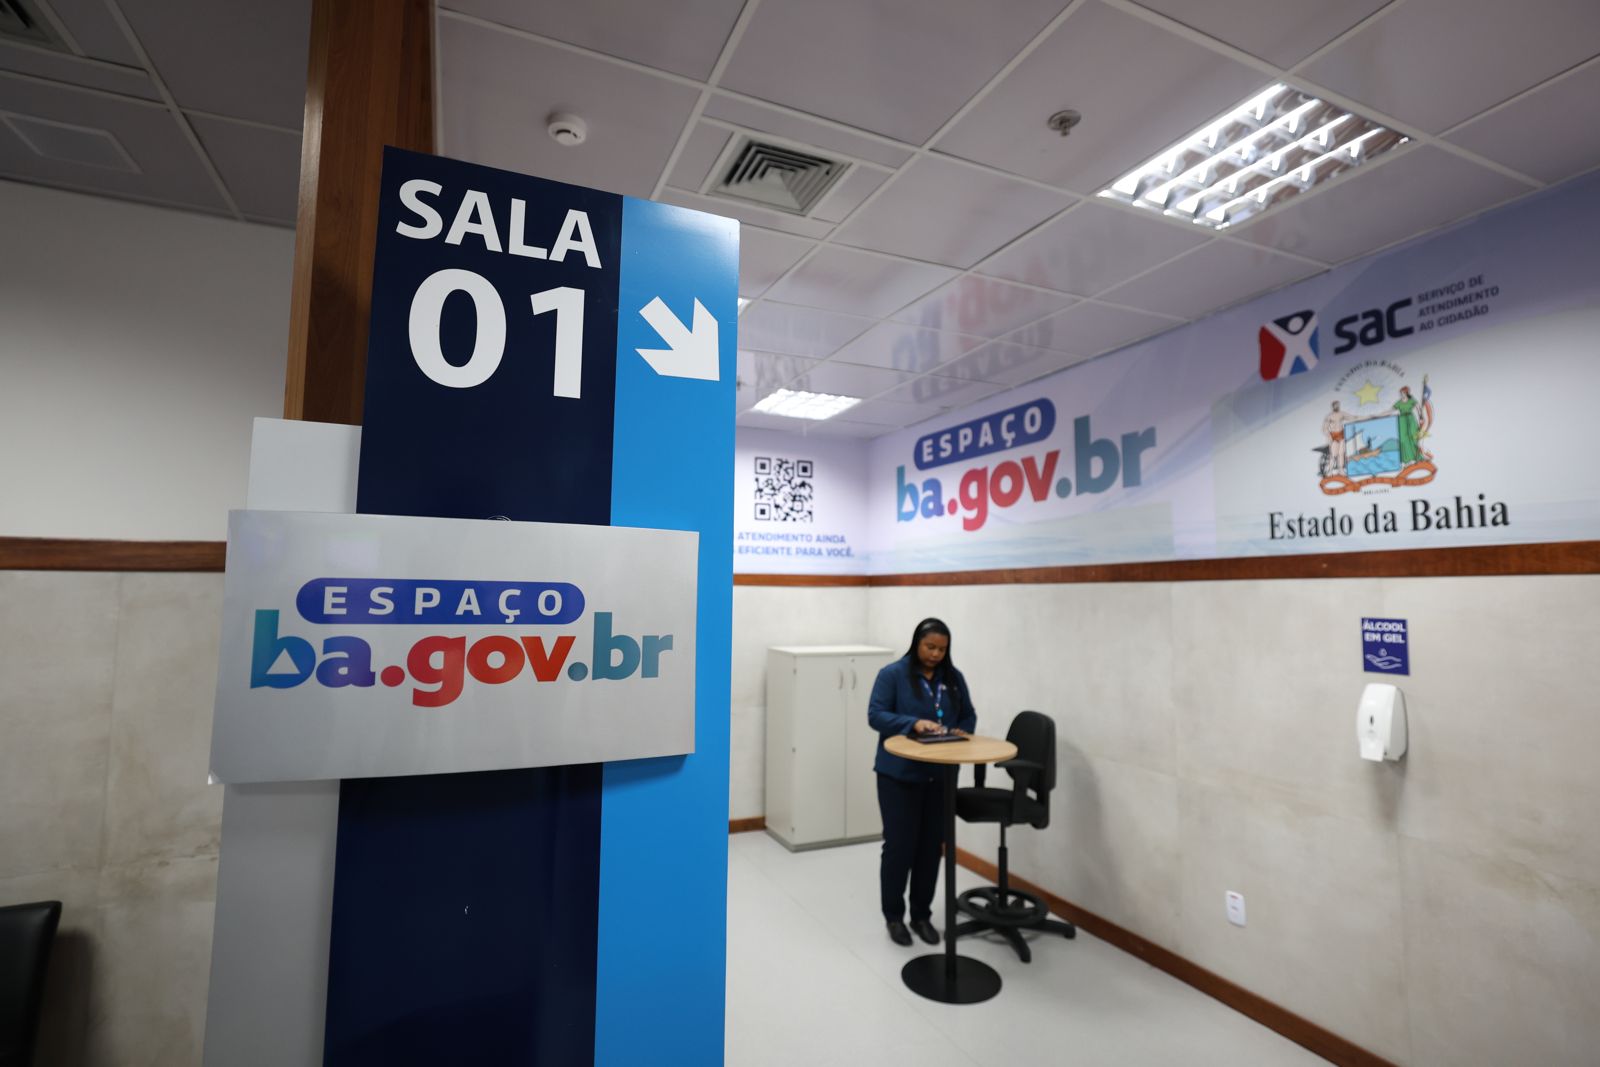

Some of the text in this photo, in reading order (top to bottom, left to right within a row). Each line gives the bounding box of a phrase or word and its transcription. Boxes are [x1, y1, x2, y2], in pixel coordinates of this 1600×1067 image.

[395, 178, 602, 269] SALA
[1468, 274, 1484, 288] DE
[1417, 285, 1499, 318] ATENDIMENTO
[1419, 304, 1489, 332] AO CIDADÃO
[408, 268, 585, 399] 01
[921, 406, 1042, 463] ESPAÇO
[897, 415, 1157, 531] ba.gov.br
[1268, 493, 1510, 540] Estado da Bahia
[738, 532, 846, 543] ATENDIMENTO AINDA
[738, 546, 792, 556] EFICIENTE
[795, 547, 823, 556] PARA
[322, 586, 563, 623] ESPAÇO
[1364, 632, 1405, 643] EM GEL
[250, 609, 674, 708] ba.gov.br
